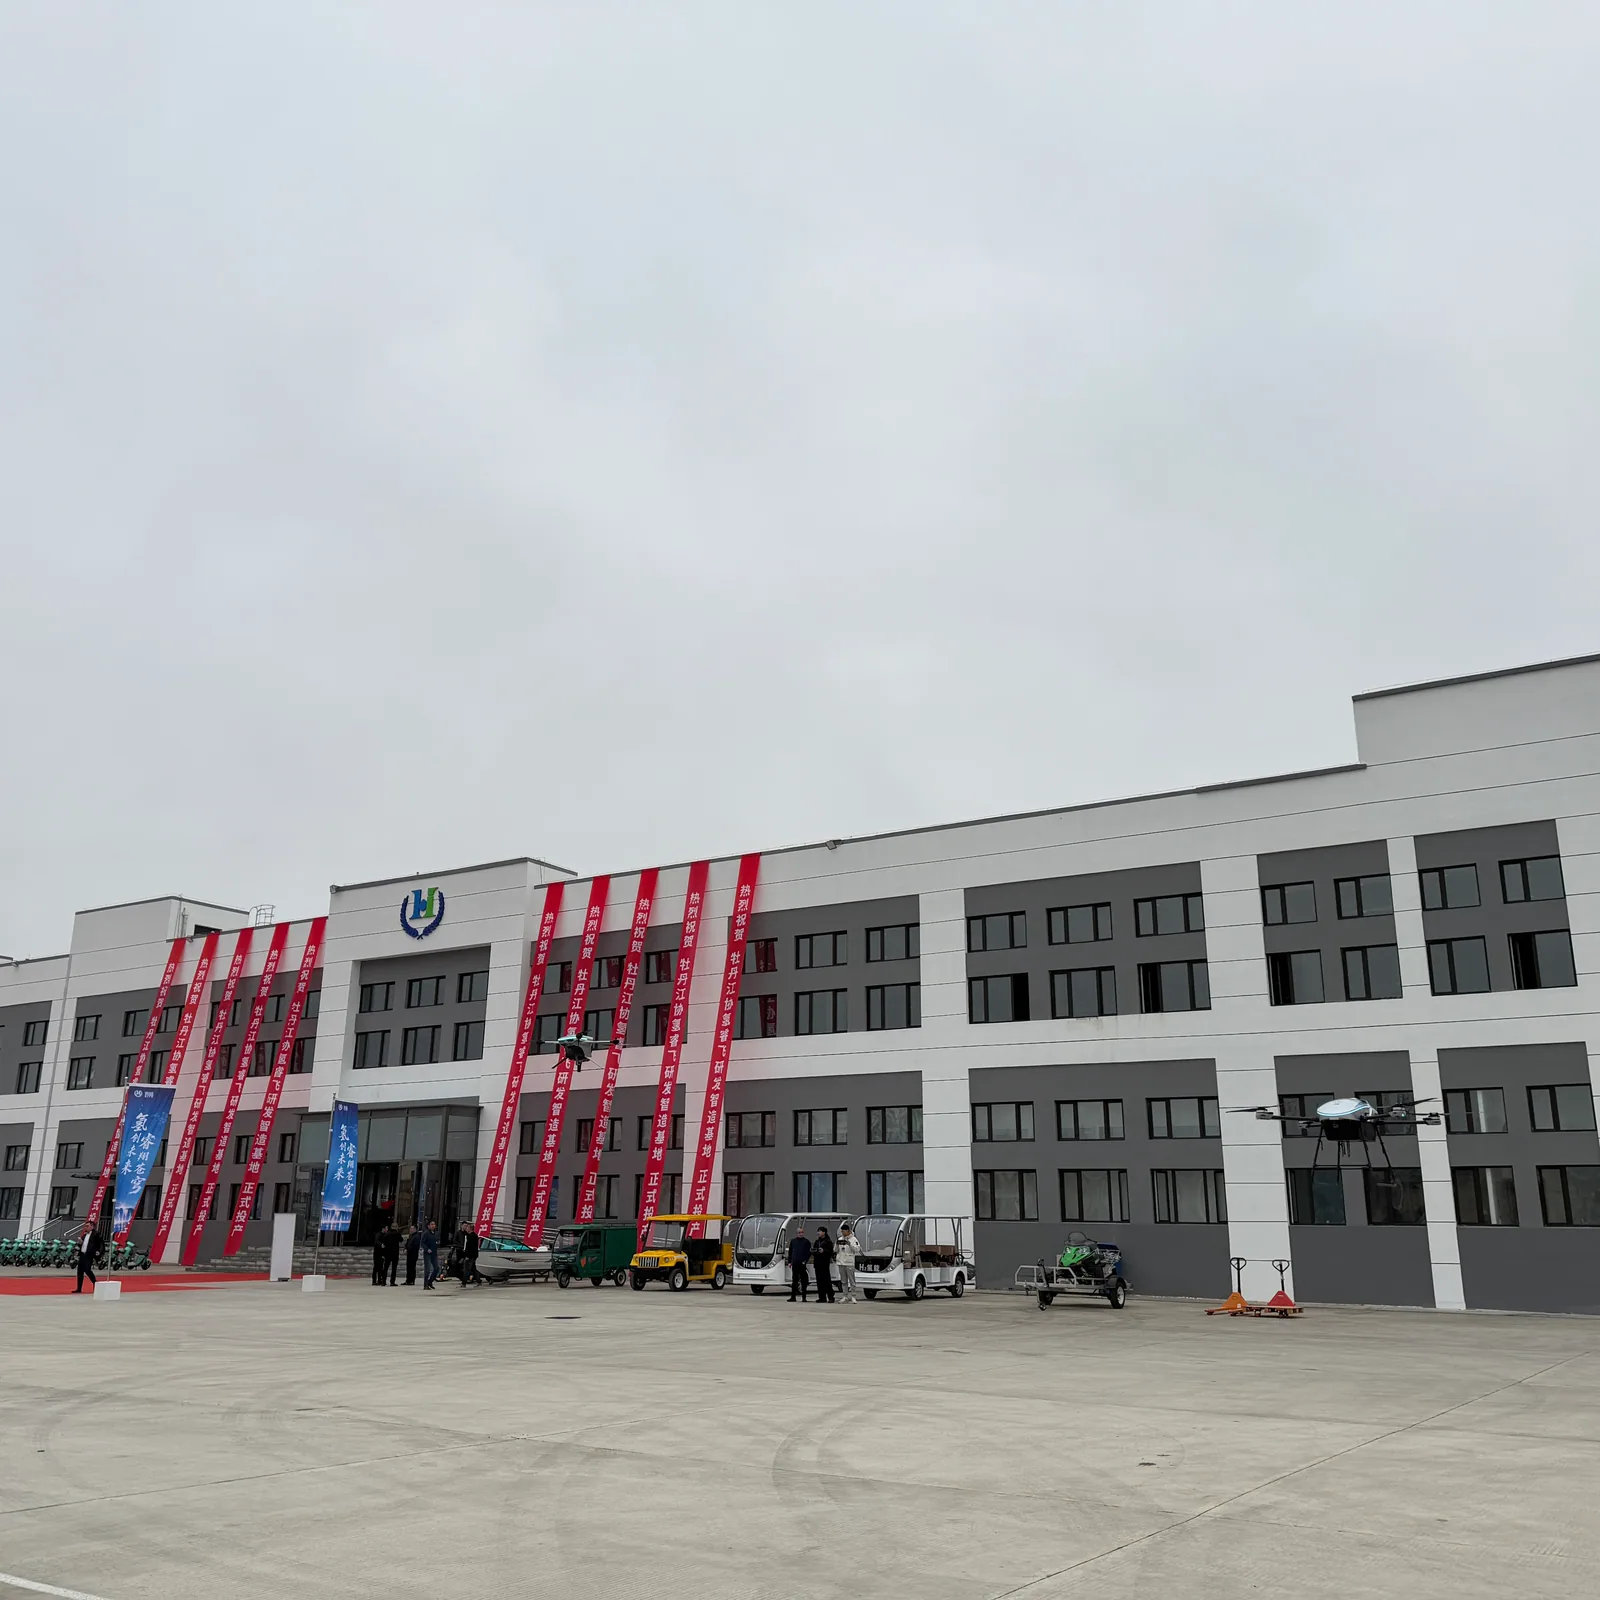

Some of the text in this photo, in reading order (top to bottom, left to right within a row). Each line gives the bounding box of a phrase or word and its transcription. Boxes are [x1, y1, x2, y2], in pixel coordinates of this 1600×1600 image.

[536, 912, 554, 966] 热烈祝贺
[581, 906, 600, 959] 热烈祝贺
[631, 898, 650, 953] 热烈祝贺
[683, 892, 700, 948] 热烈祝贺
[734, 884, 750, 941] 热烈祝贺
[156, 963, 175, 1009] 热烈祝贺
[189, 958, 208, 1004] 热烈祝贺
[223, 955, 243, 1001] 热烈祝贺
[259, 949, 278, 997] 热烈祝贺
[297, 945, 315, 993] 热烈祝贺
[193, 1182, 216, 1236] 正式投产
[231, 1182, 255, 1237] 正式投产
[528, 1174, 549, 1238] 正式投产
[581, 1171, 597, 1223] 正式投
[689, 1169, 708, 1237] 正式投产
